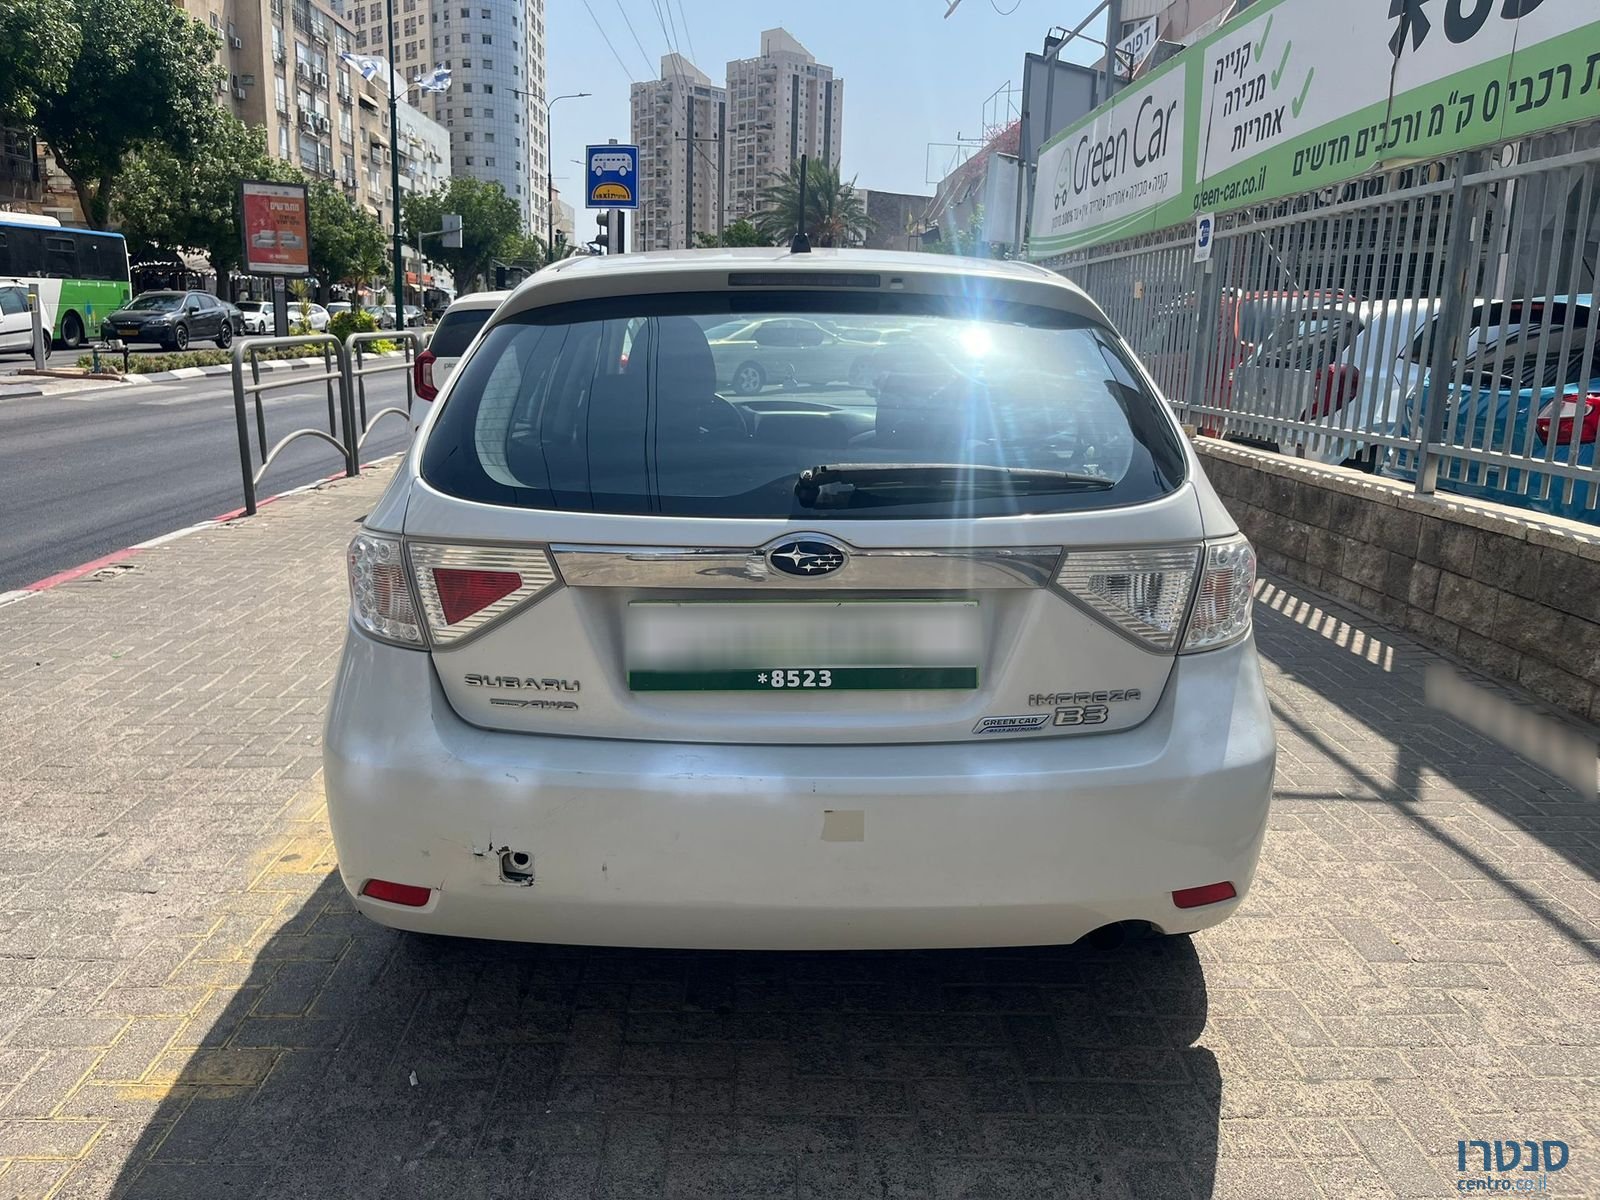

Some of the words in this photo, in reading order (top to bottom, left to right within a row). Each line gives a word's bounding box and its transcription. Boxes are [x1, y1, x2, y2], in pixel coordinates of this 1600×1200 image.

[1124, 26, 1151, 60] דפוס
[1213, 41, 1252, 85] קנייה
[1223, 73, 1267, 117] מכירה
[1482, 79, 1500, 123] 0
[1508, 63, 1572, 114] רכבי
[1073, 128, 1128, 195] Green
[1133, 95, 1177, 168] Car
[1231, 105, 1285, 152] אחריות
[1354, 110, 1423, 158] ורכבים
[1292, 135, 1350, 177] חדשים
[464, 673, 580, 692] SUBARU
[1028, 688, 1142, 706] IMPREZA
[983, 718, 1017, 726] GREEN
[1018, 717, 1038, 725] CAR
[1053, 704, 1108, 726] B3
